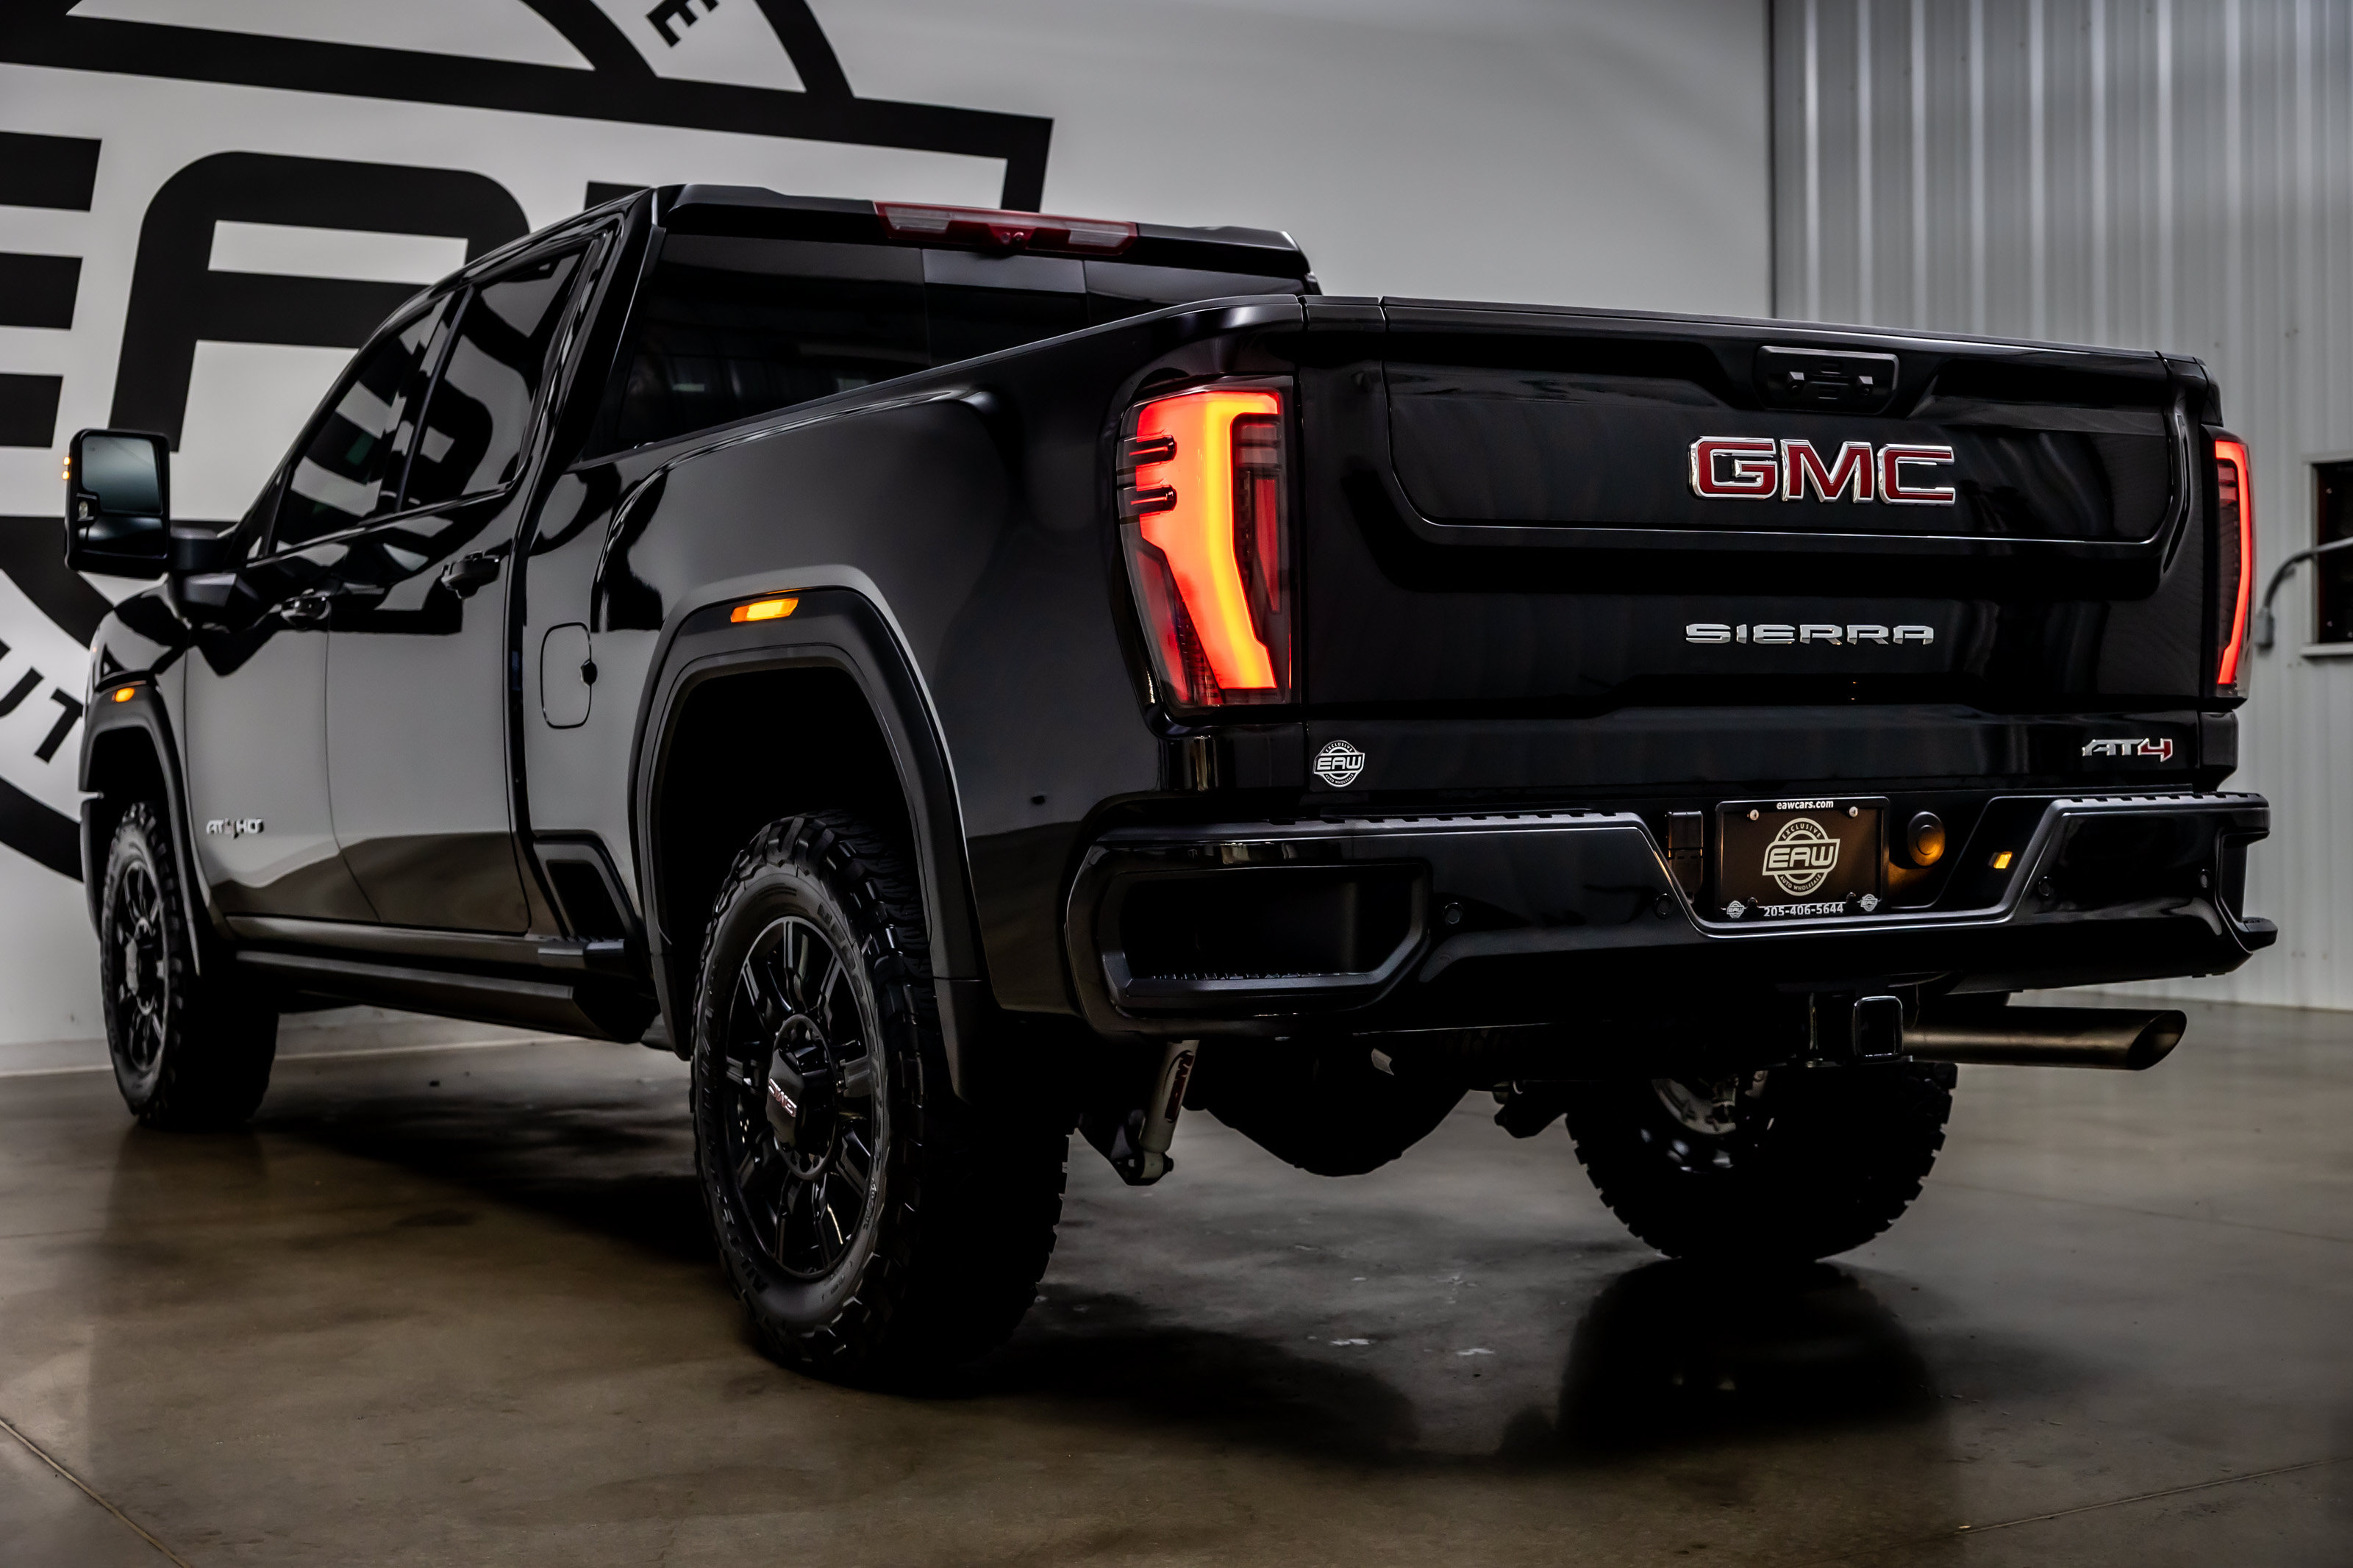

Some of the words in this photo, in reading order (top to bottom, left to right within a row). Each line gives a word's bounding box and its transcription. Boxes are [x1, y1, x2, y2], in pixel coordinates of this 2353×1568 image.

[1690, 436, 1956, 506] GMC
[1685, 623, 1935, 645] SIERRA
[1326, 742, 1352, 753] EXCLUSIVE
[2082, 737, 2173, 762] AT4
[1317, 756, 1361, 770] EAW
[1326, 774, 1335, 783] AUTO
[1777, 800, 1834, 810] eawcars.com
[1782, 823, 1822, 840] EXCLUSIVE
[1768, 845, 1834, 868] EAW
[1779, 876, 1793, 889] AUTO
[1793, 873, 1822, 891] WHOLESALE
[1763, 903, 1844, 917] 205-406-5644
